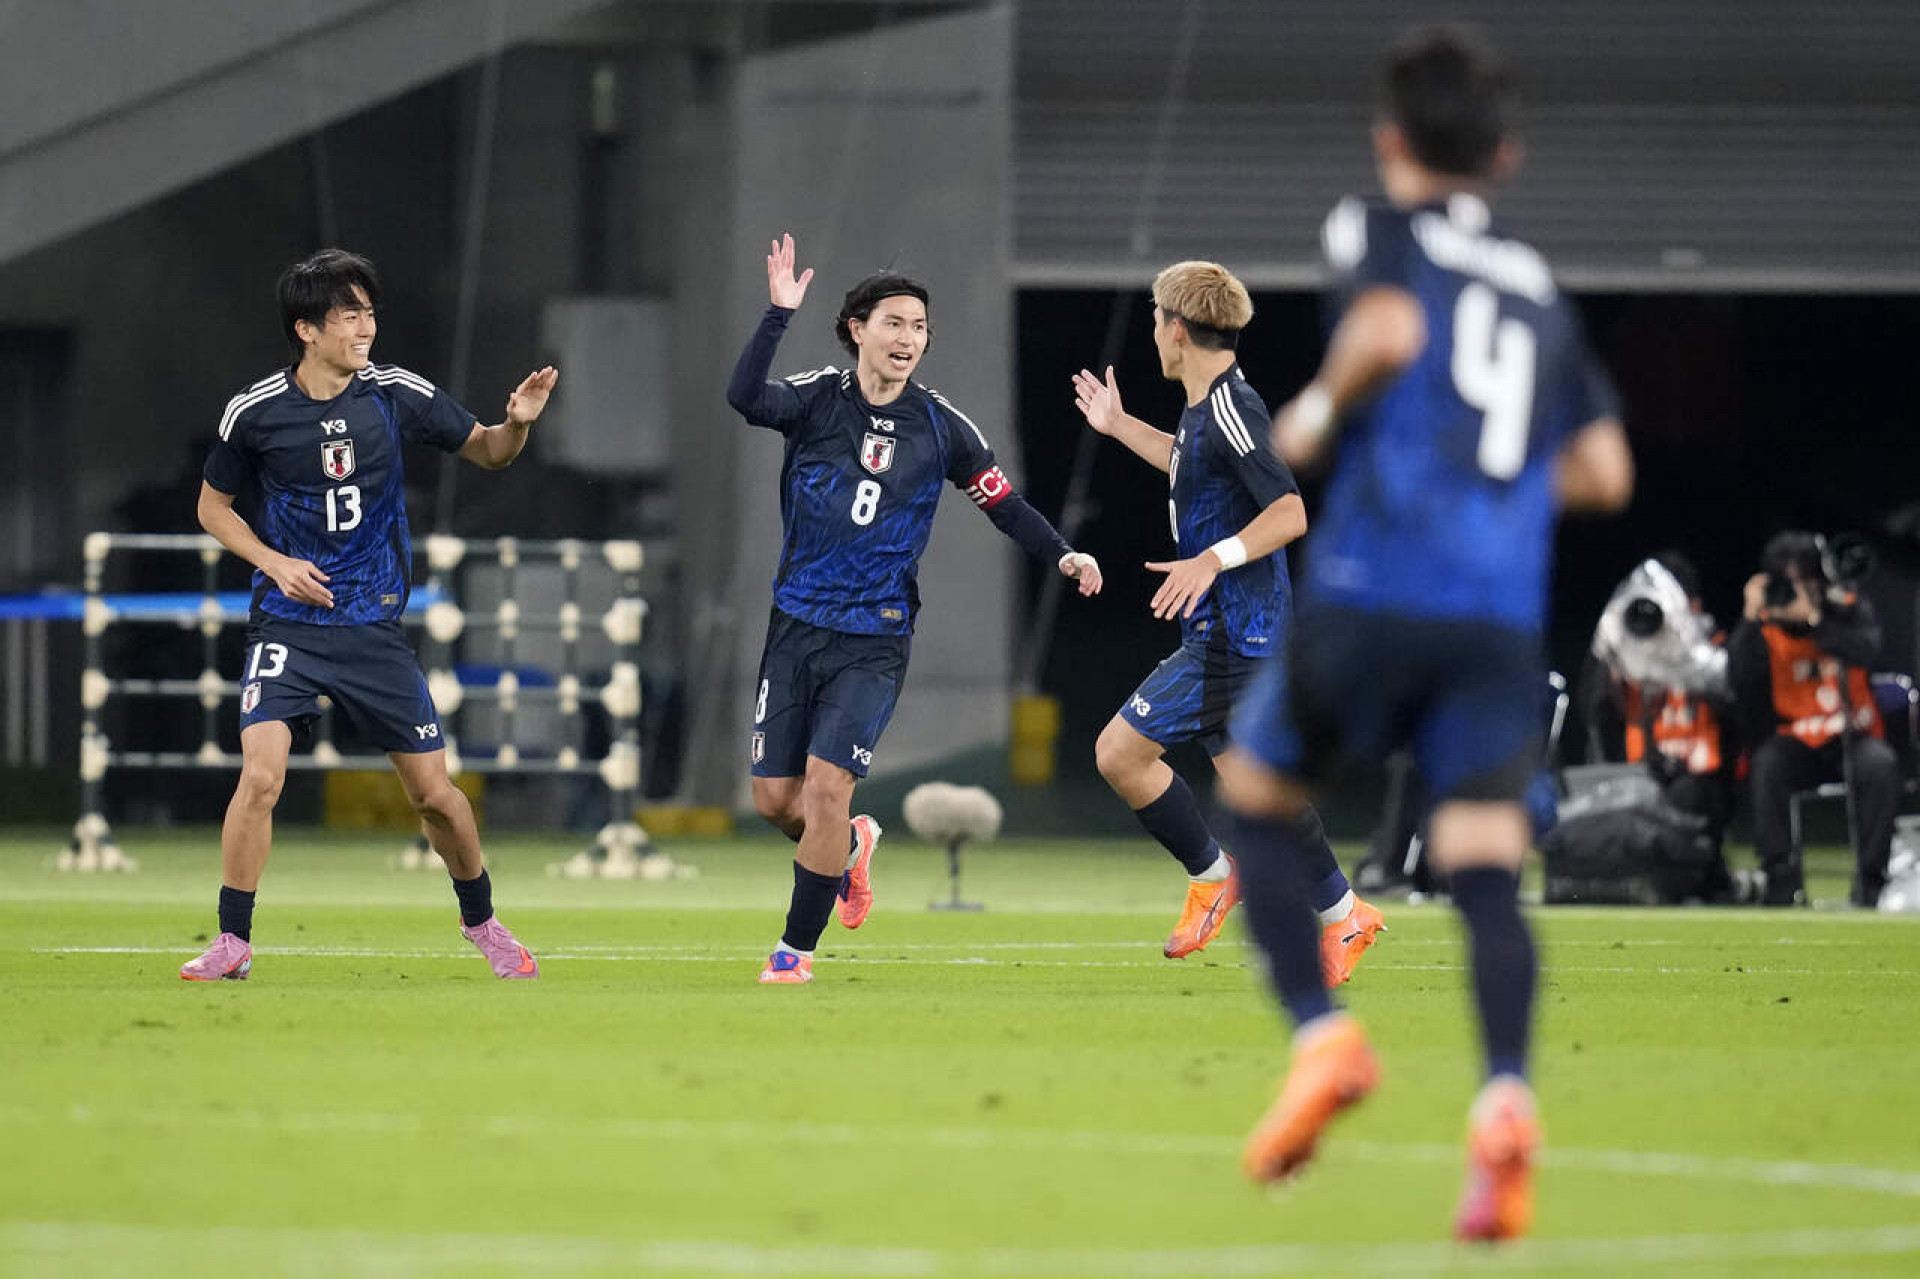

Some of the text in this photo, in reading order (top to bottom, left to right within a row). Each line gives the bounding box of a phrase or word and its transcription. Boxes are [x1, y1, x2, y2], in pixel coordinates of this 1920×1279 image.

[1452, 280, 1537, 481] 4
[320, 419, 348, 436] Y-3
[870, 416, 895, 431] Y-3
[979, 472, 1003, 497] C
[326, 485, 363, 532] 13
[850, 479, 882, 525] 8
[248, 642, 289, 680] 13
[755, 678, 769, 724] 8
[414, 723, 439, 740] Y-3
[852, 744, 873, 766] Y-3
